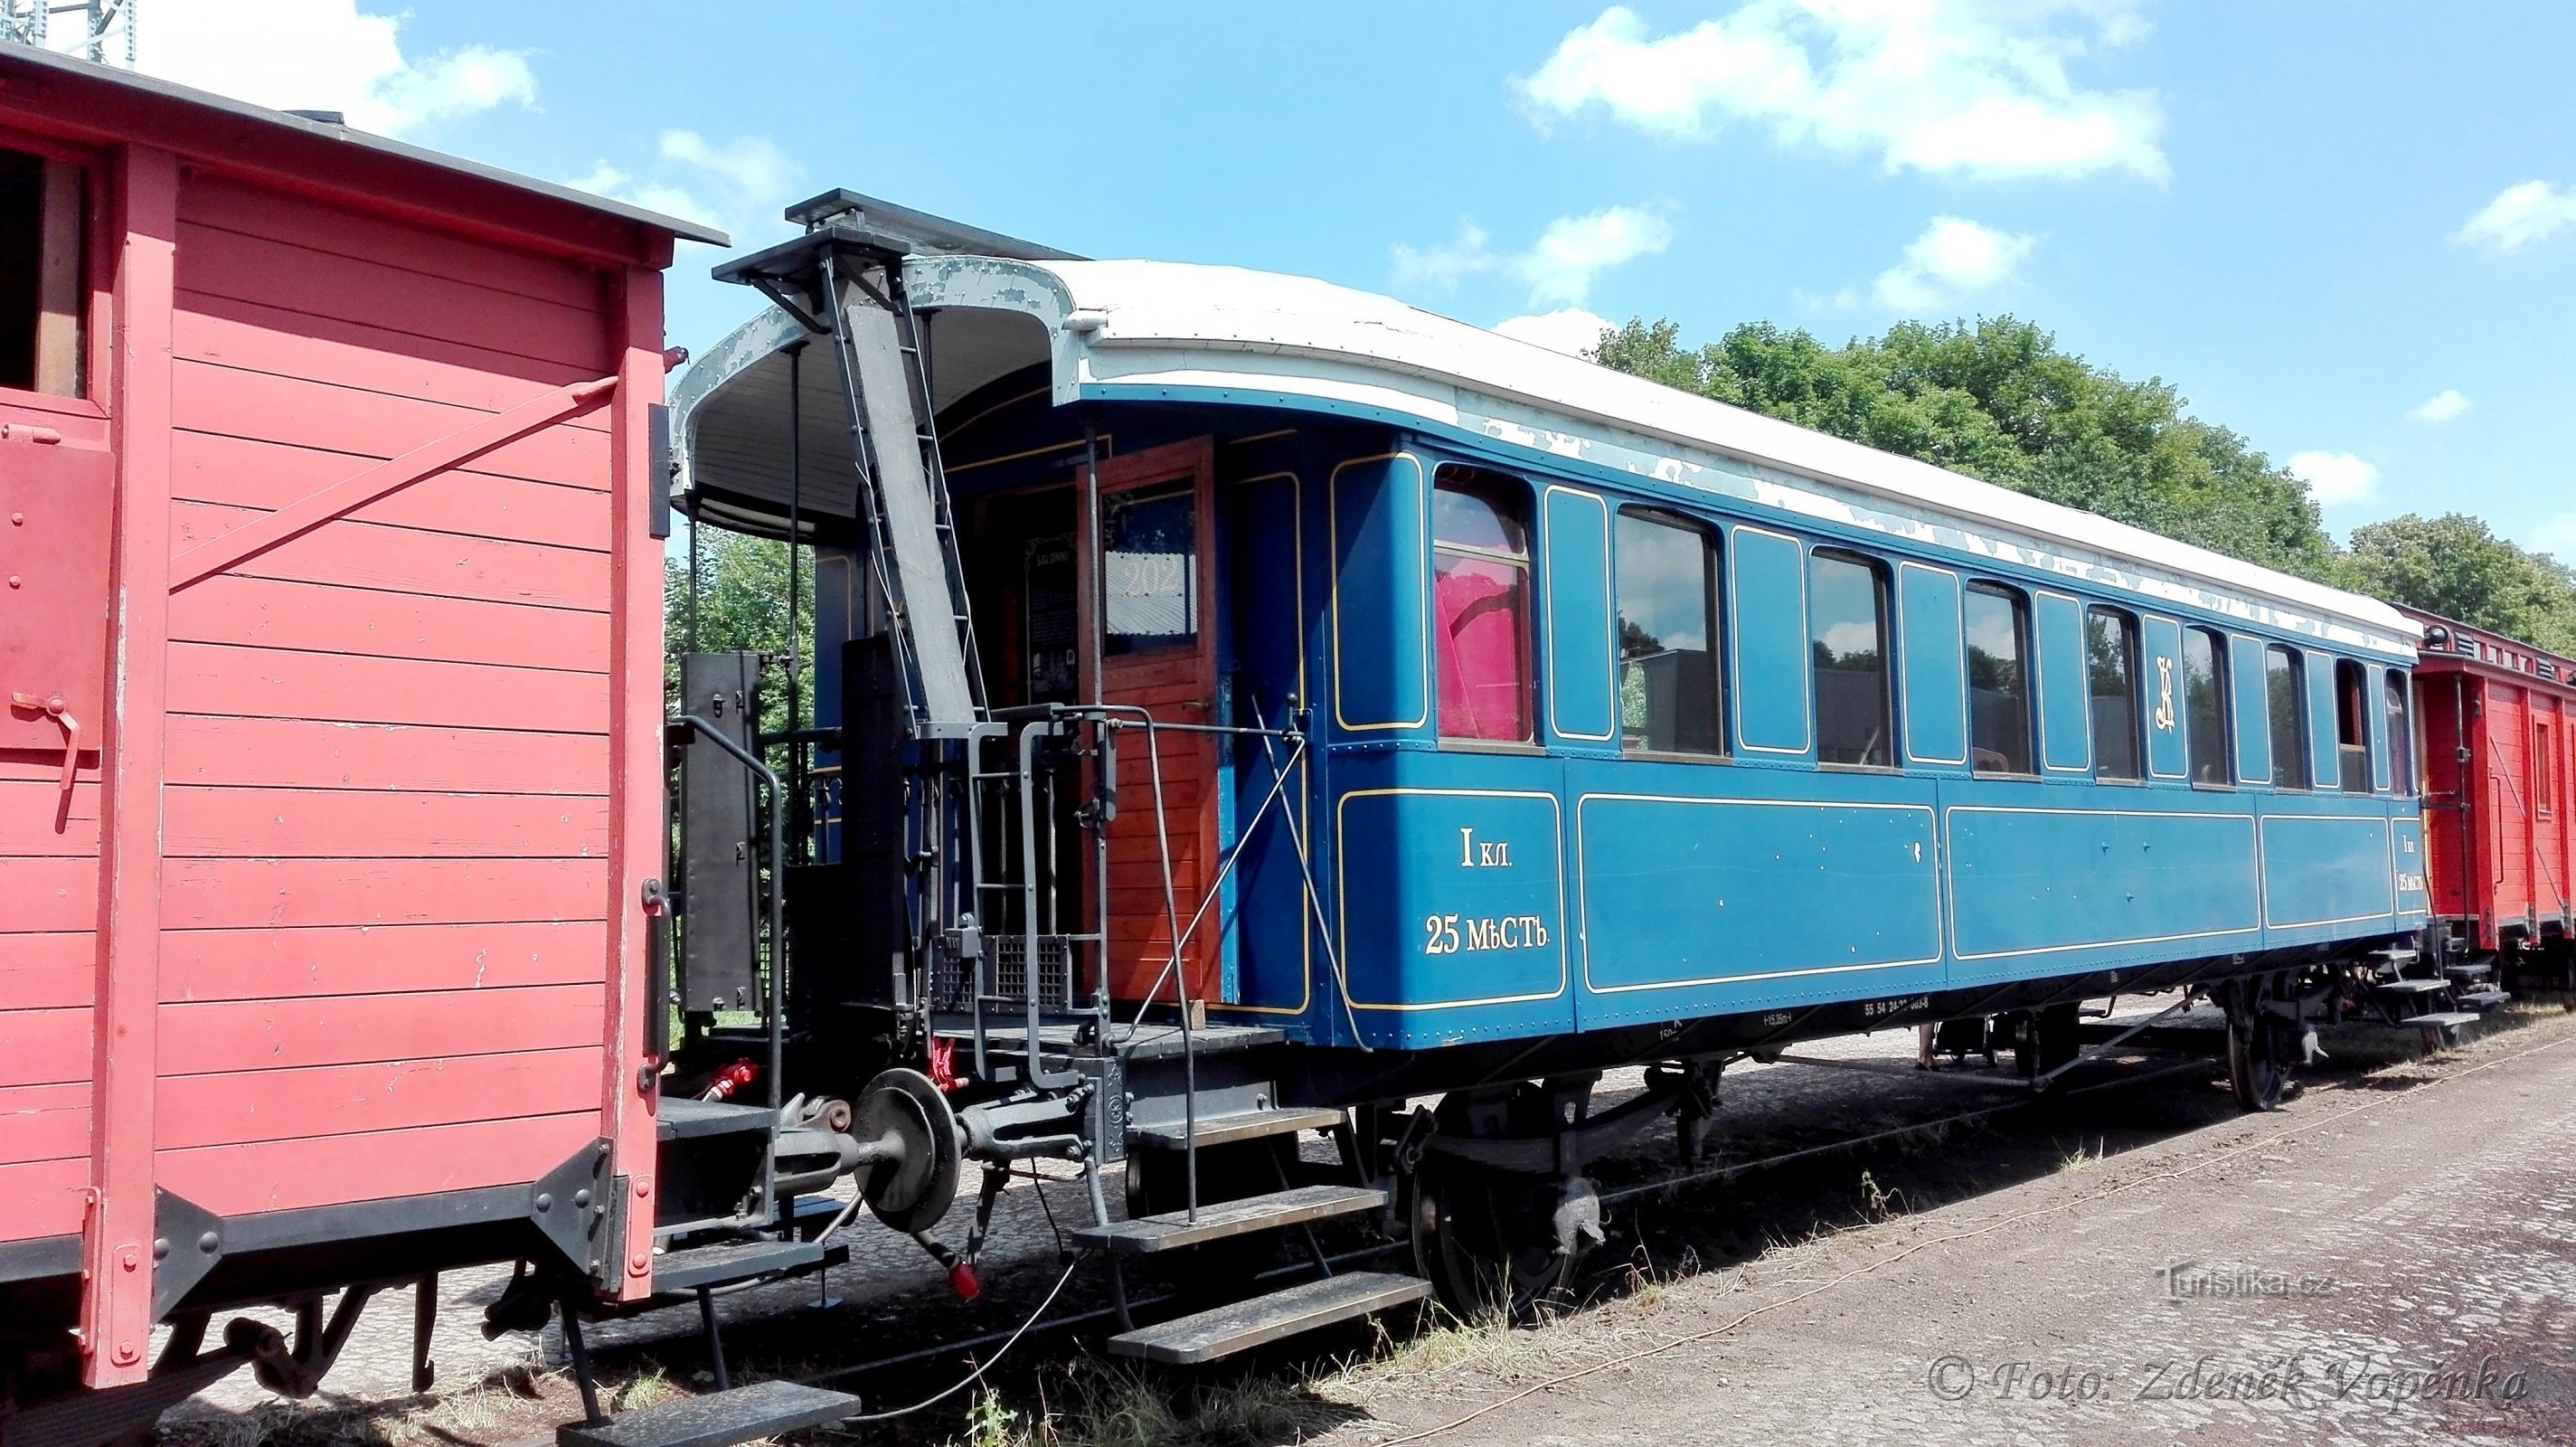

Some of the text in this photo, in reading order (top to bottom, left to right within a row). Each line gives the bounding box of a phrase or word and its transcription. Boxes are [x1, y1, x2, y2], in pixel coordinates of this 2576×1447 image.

[1124, 556, 1178, 597] 202
[1425, 913, 1460, 955] 25
[1864, 1003, 1874, 1017] 55
[1876, 1001, 1886, 1015] 54
